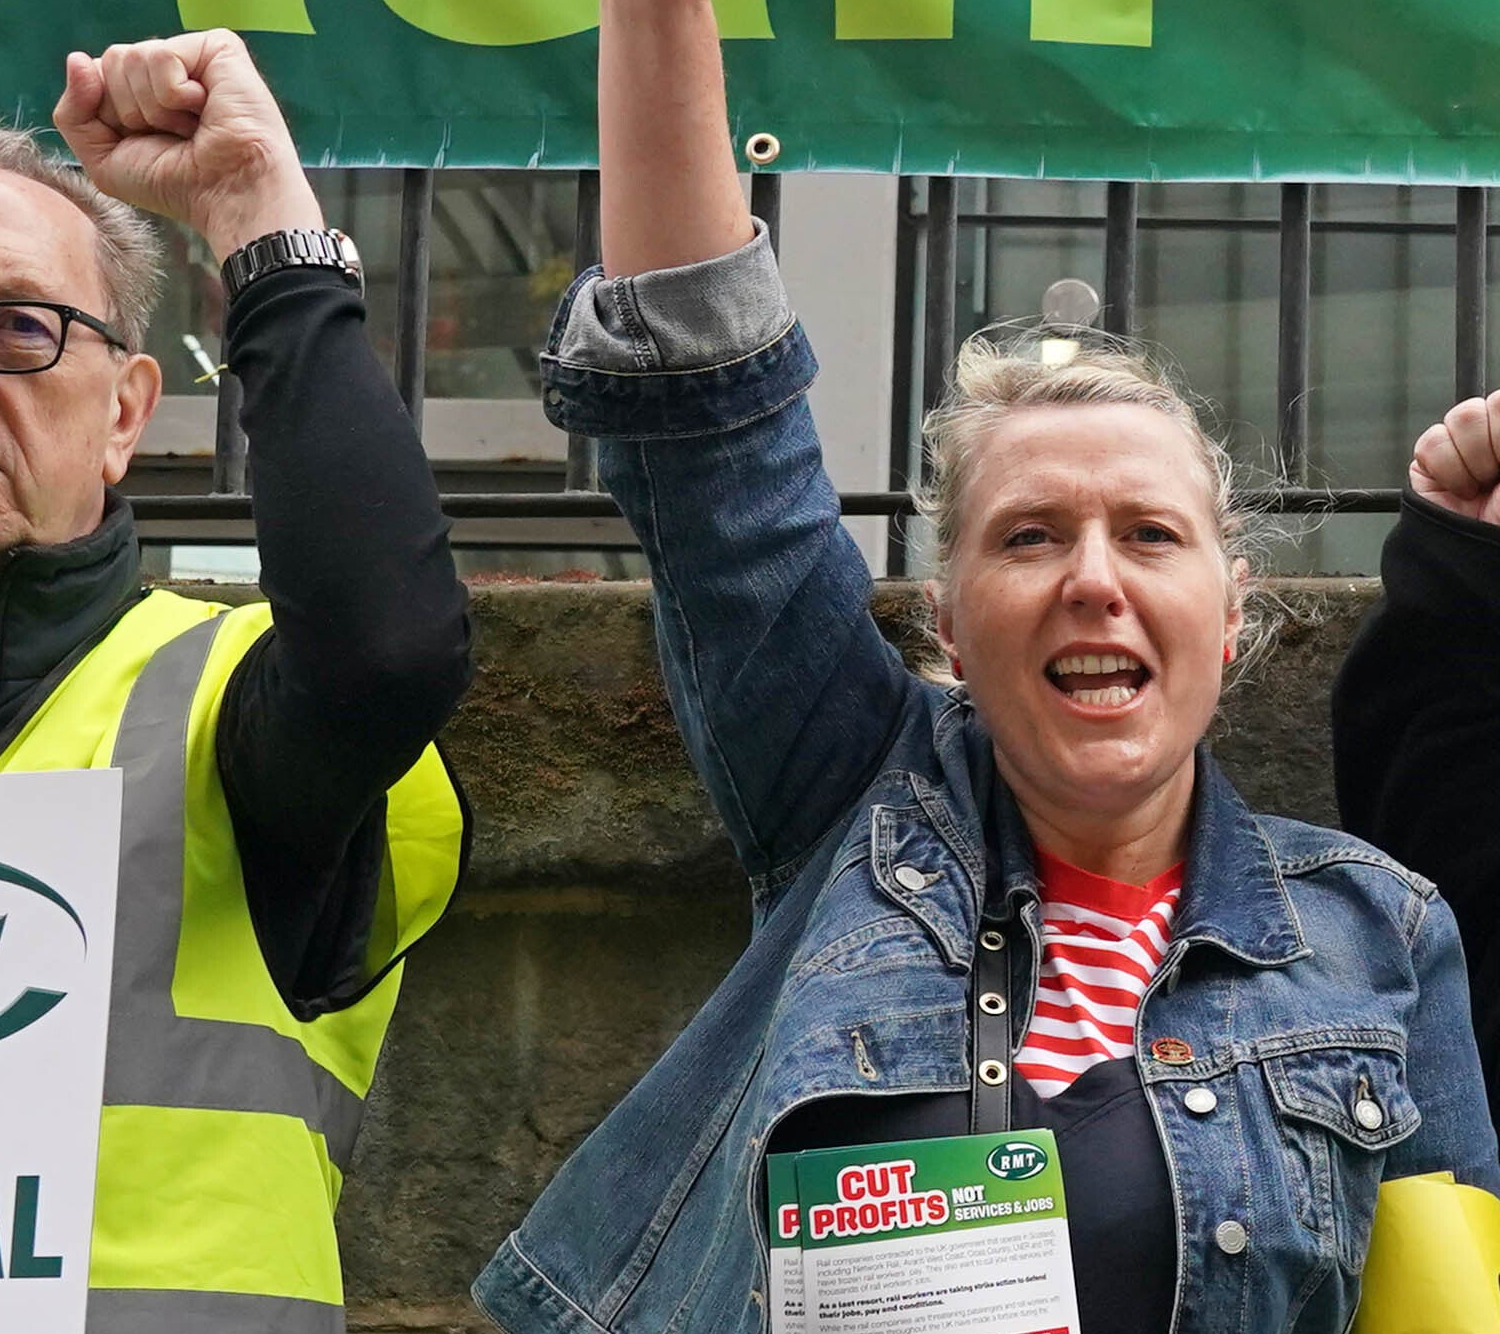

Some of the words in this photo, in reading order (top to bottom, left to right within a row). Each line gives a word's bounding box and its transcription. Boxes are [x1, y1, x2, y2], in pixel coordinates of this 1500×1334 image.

[1000, 1153, 1036, 1170] RMT
[839, 1163, 912, 1201] CUT
[952, 1185, 984, 1204] NOT
[812, 1194, 946, 1235] PROFITS
[954, 1201, 1012, 1222] SERVICES
[1013, 1201, 1023, 1212] &
[1024, 1197, 1053, 1212] JOBS
